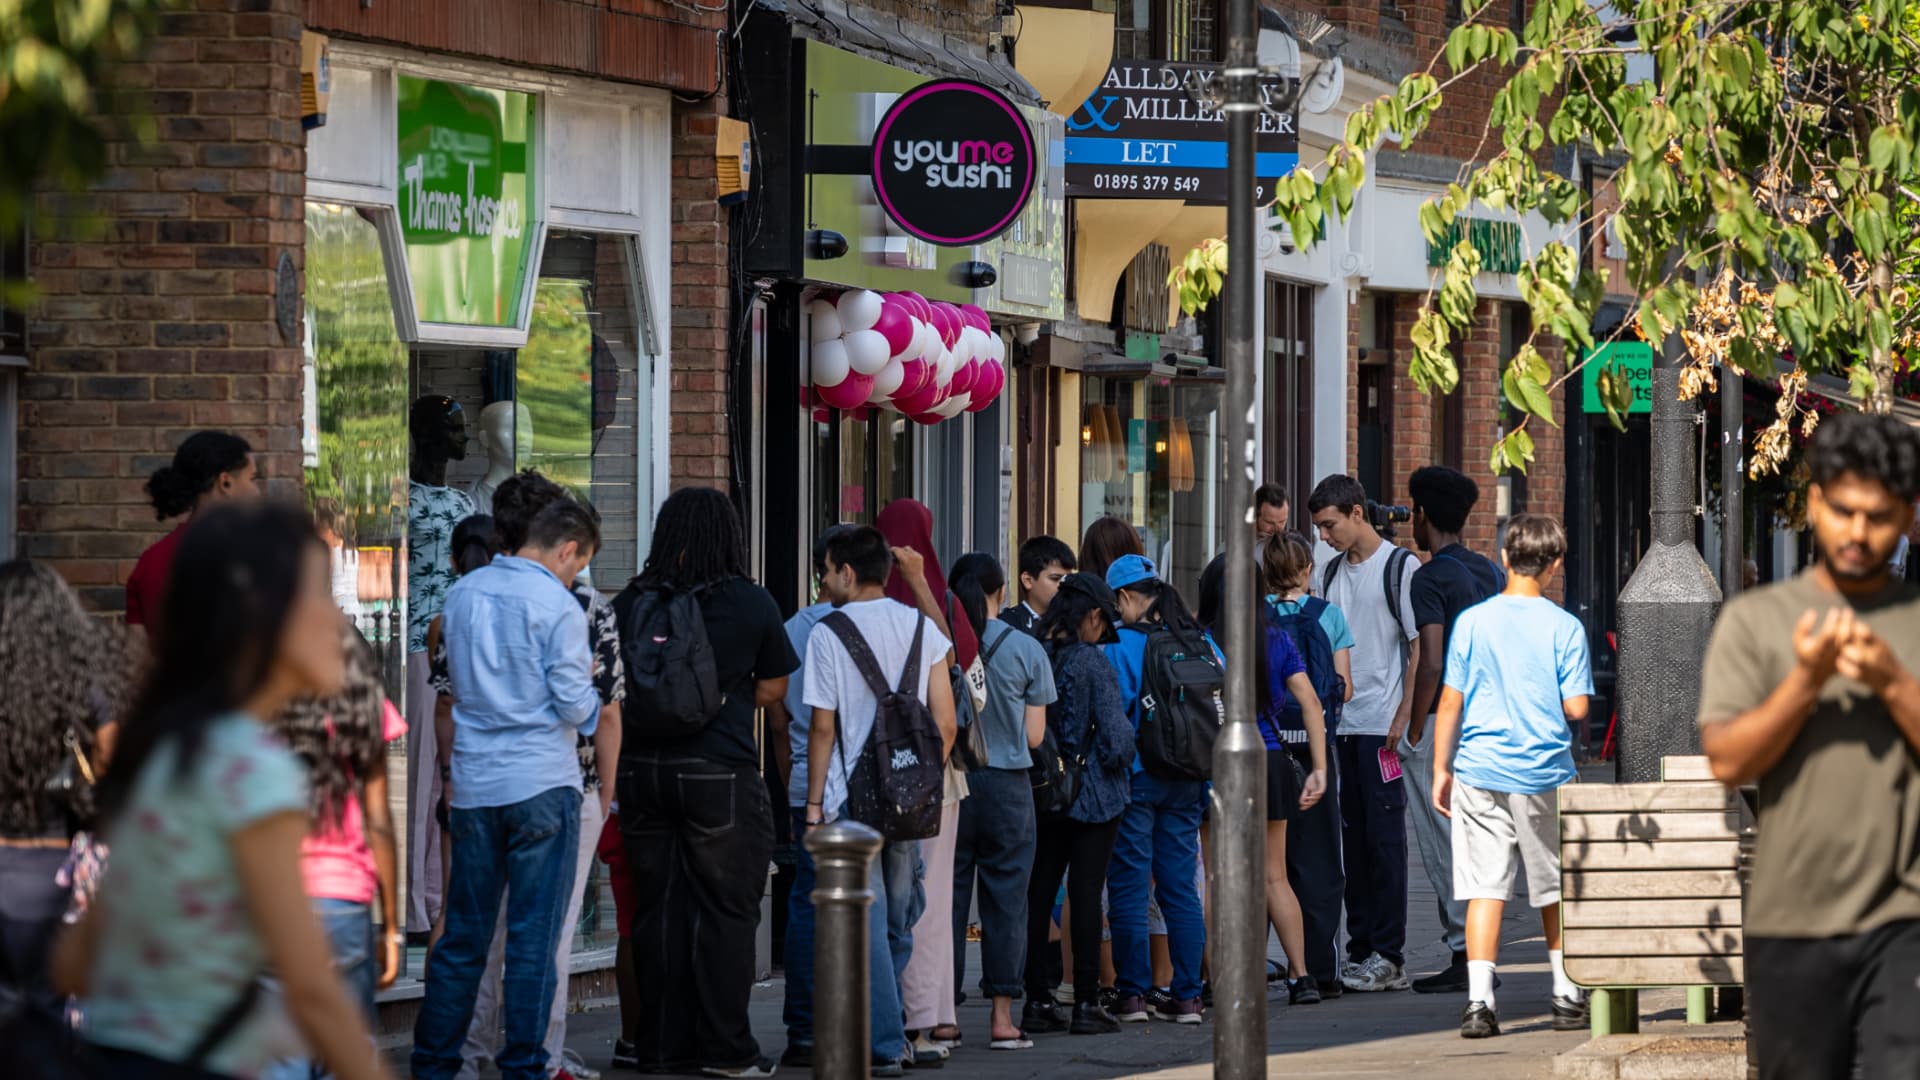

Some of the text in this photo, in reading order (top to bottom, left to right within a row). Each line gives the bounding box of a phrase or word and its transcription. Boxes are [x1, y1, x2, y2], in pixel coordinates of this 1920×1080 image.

[1121, 141, 1176, 164] LET
[926, 161, 1012, 188] sushi
[1094, 174, 1200, 192] 01895 379 549
[404, 153, 461, 233] Thames
[1279, 729, 1310, 743] PUM
